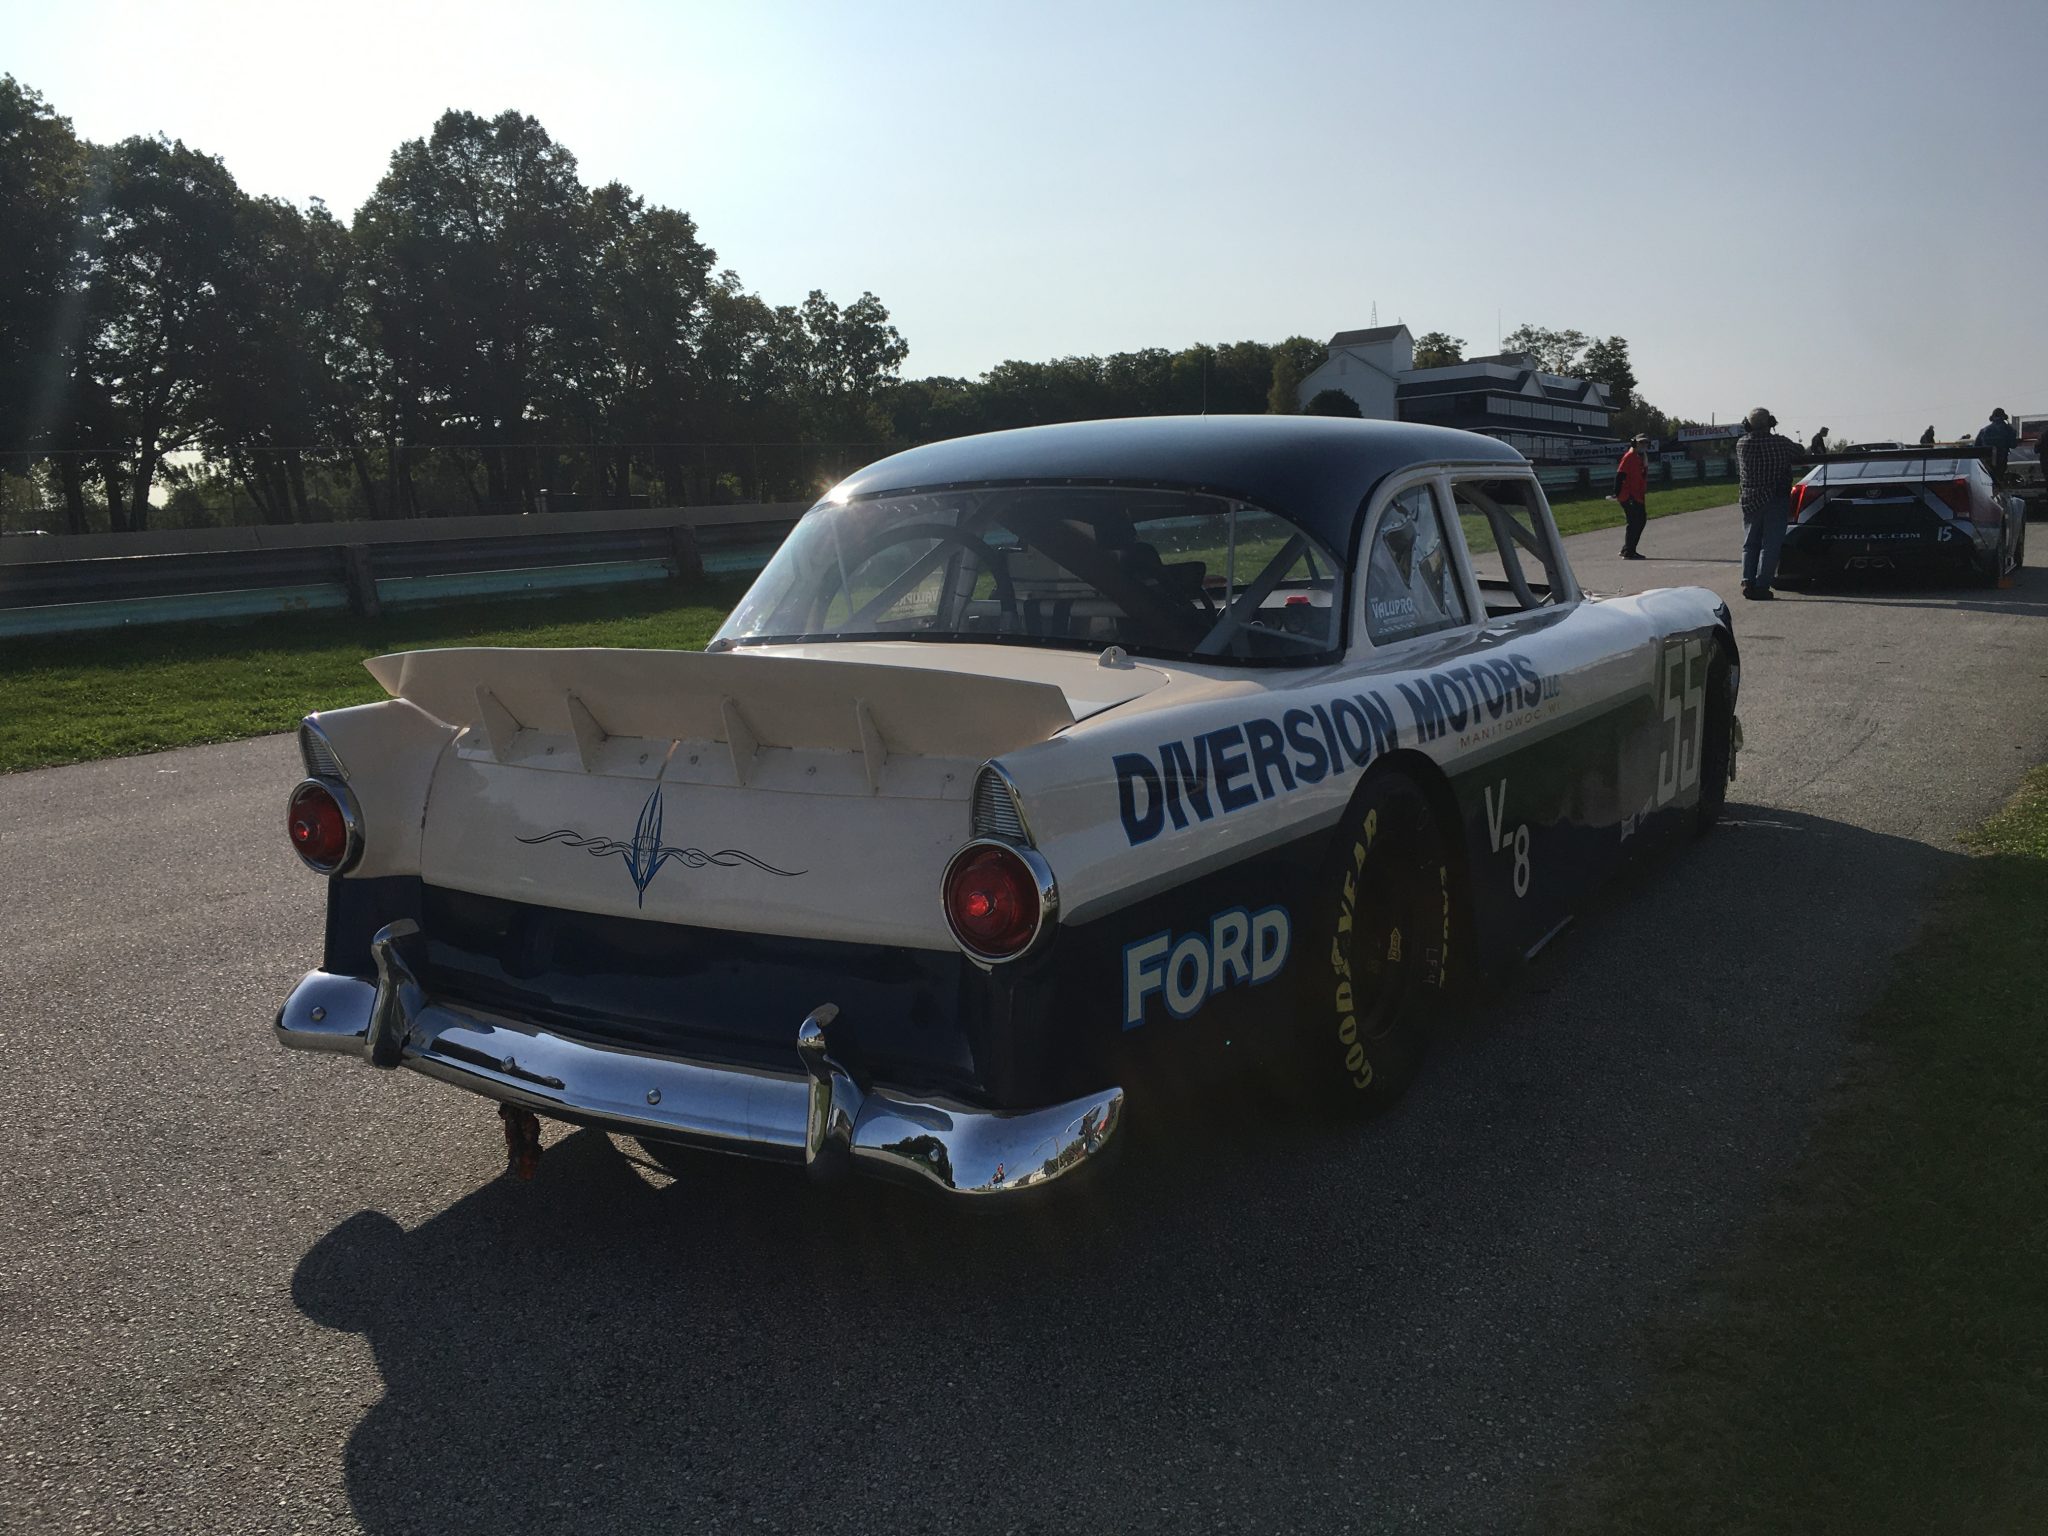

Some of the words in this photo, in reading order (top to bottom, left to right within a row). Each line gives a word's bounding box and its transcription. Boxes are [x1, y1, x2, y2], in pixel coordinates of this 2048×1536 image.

[1821, 532, 1921, 541] CADILLAC.COM
[1937, 525, 1953, 542] 15
[1112, 690, 1399, 847] DIVERSION
[1394, 653, 1542, 745] MOTORS
[1542, 674, 1561, 701] LLC
[1657, 638, 1703, 807] 55
[1483, 777, 1530, 898] V-8
[1122, 903, 1292, 1033] FORD
[1331, 808, 1378, 1090] GOODYEAR
